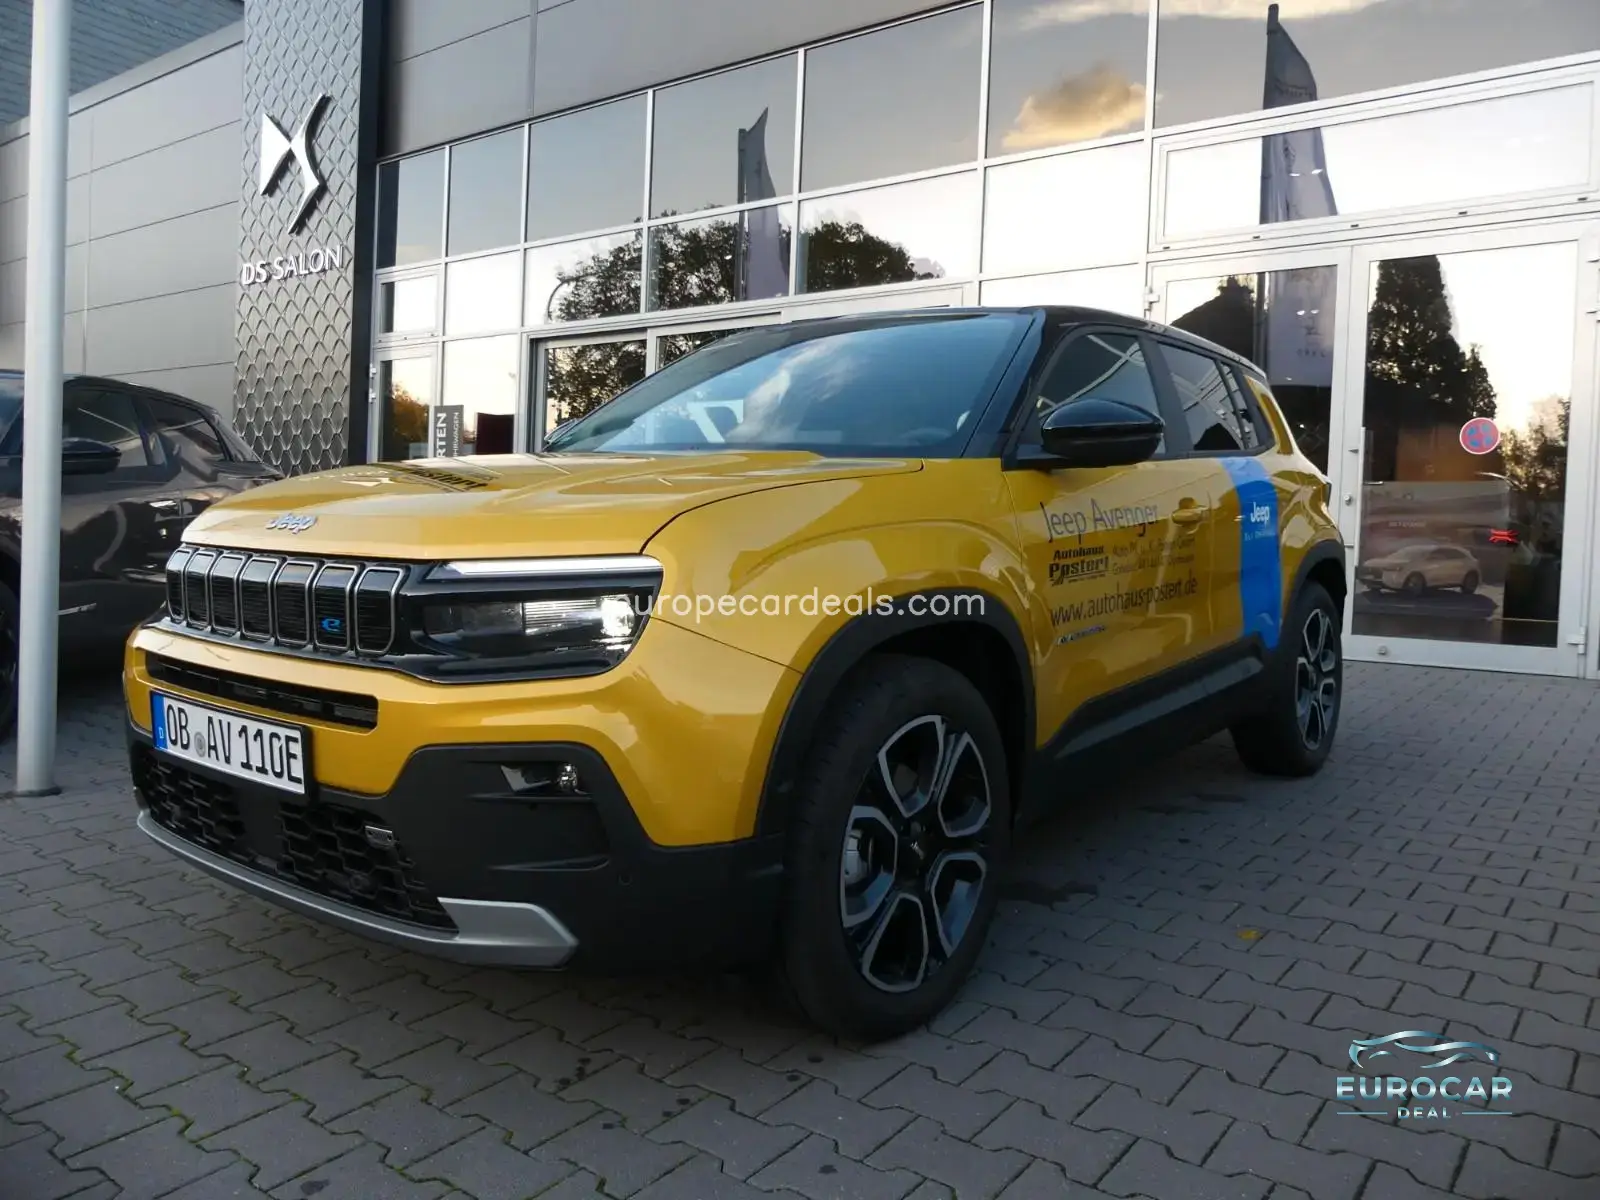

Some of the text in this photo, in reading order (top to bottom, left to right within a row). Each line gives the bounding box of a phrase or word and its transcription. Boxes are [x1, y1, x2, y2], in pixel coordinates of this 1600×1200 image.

[242, 245, 342, 286] DS SALON
[265, 513, 318, 534] Jeep
[1040, 498, 1158, 544] Jeep Avenger
[1250, 501, 1270, 528] Jeep
[1053, 546, 1104, 561] Autohaus
[166, 704, 302, 784] OB AV 110E
